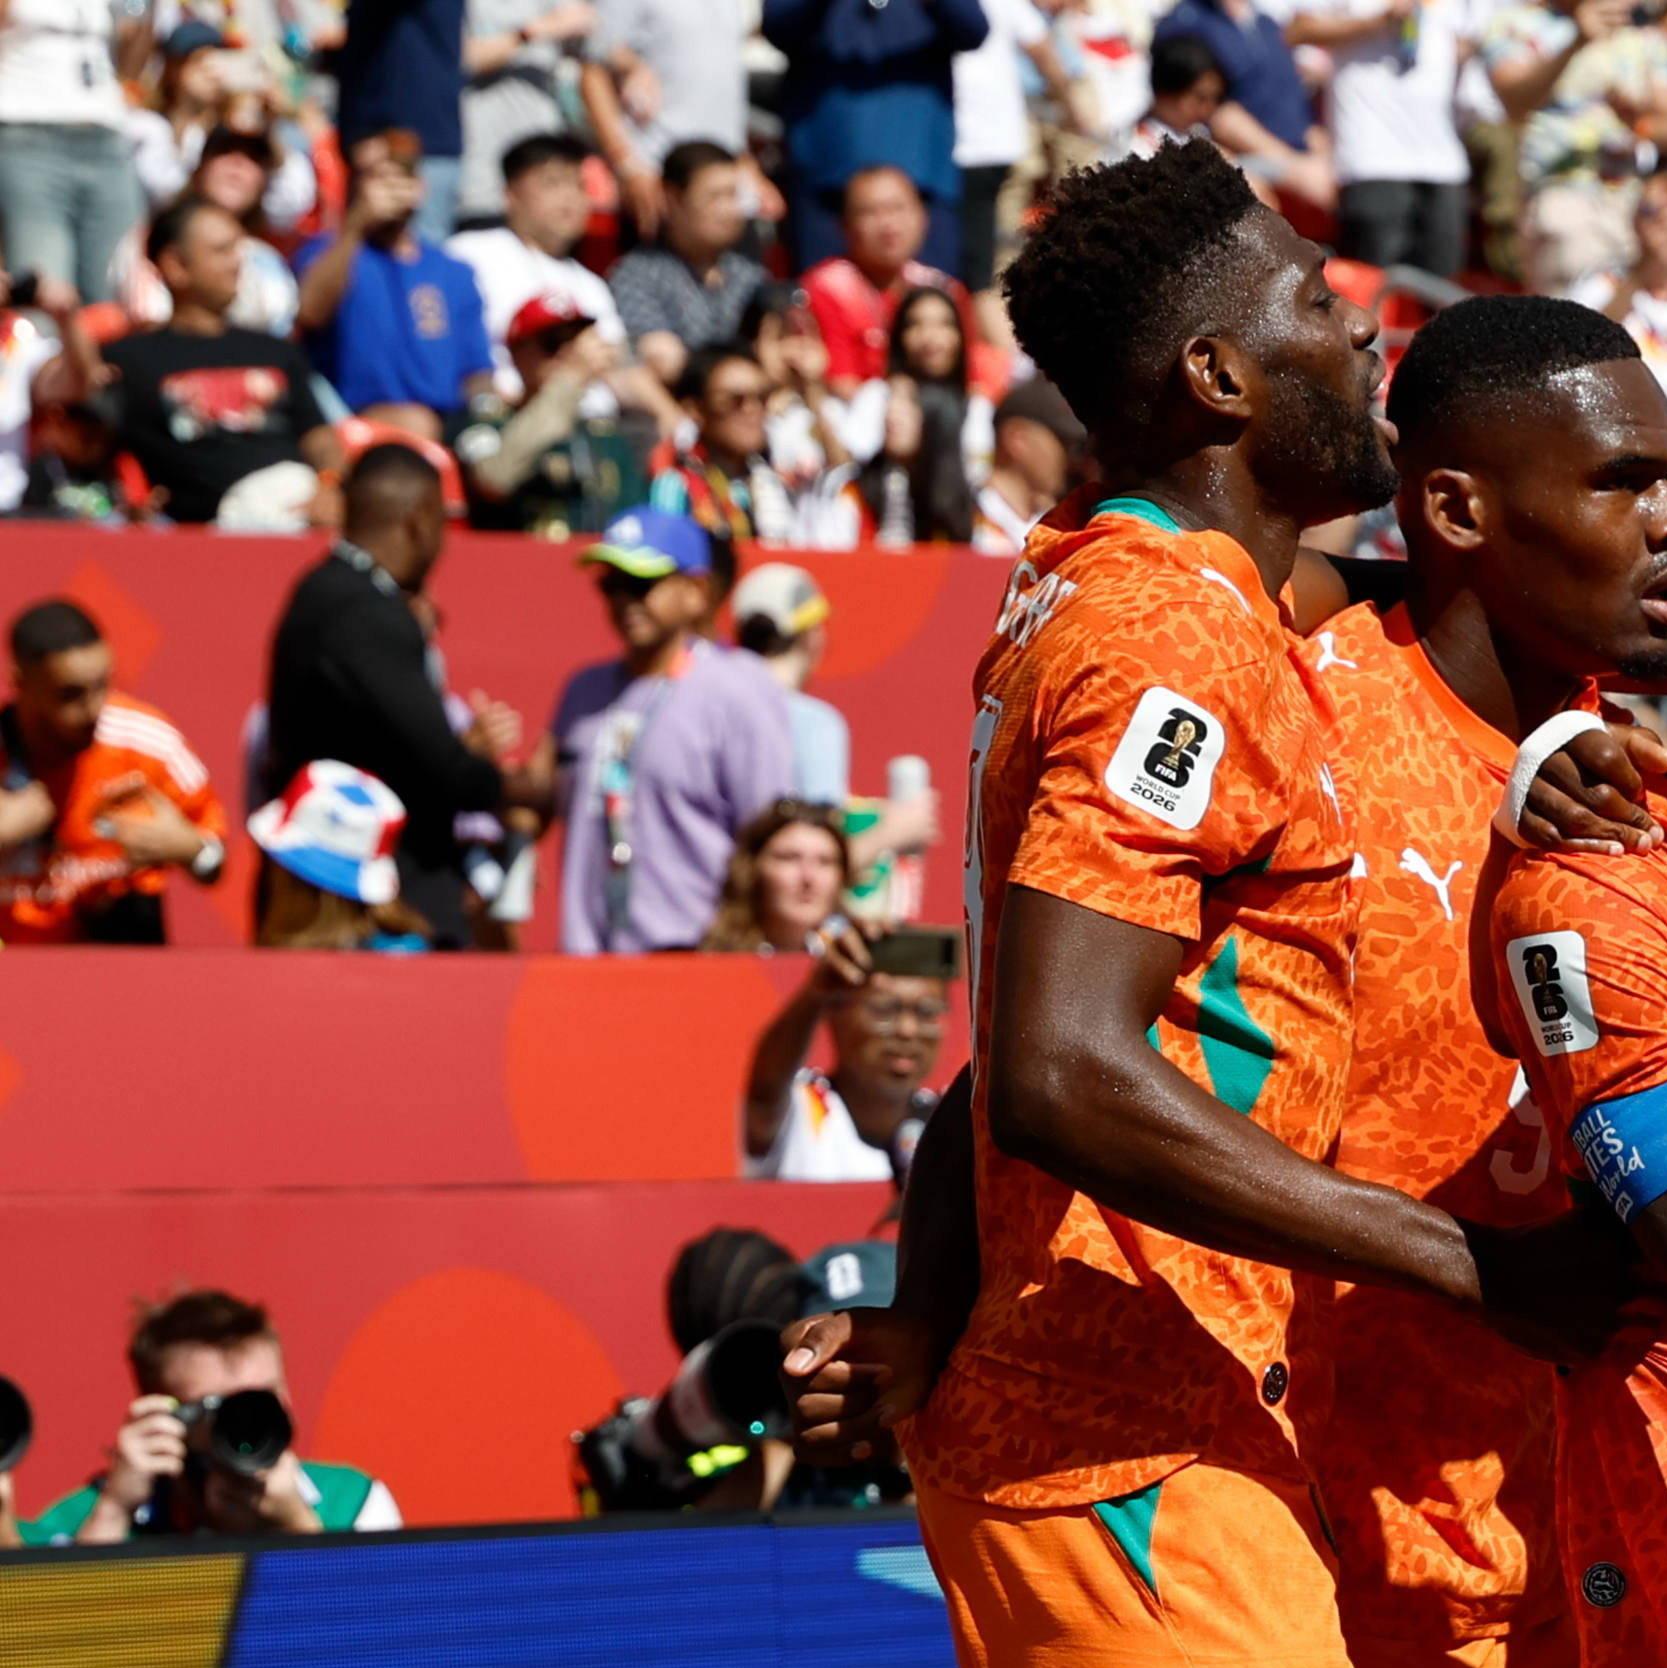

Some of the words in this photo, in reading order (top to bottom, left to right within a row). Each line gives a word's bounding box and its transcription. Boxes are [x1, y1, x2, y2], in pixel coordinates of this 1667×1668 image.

[1154, 763, 1178, 782] FIFA
[1130, 783, 1177, 812] 2026
[1135, 775, 1165, 793] WORLD
[1164, 789, 1181, 801] CUP
[1572, 1108, 1612, 1154] BALL
